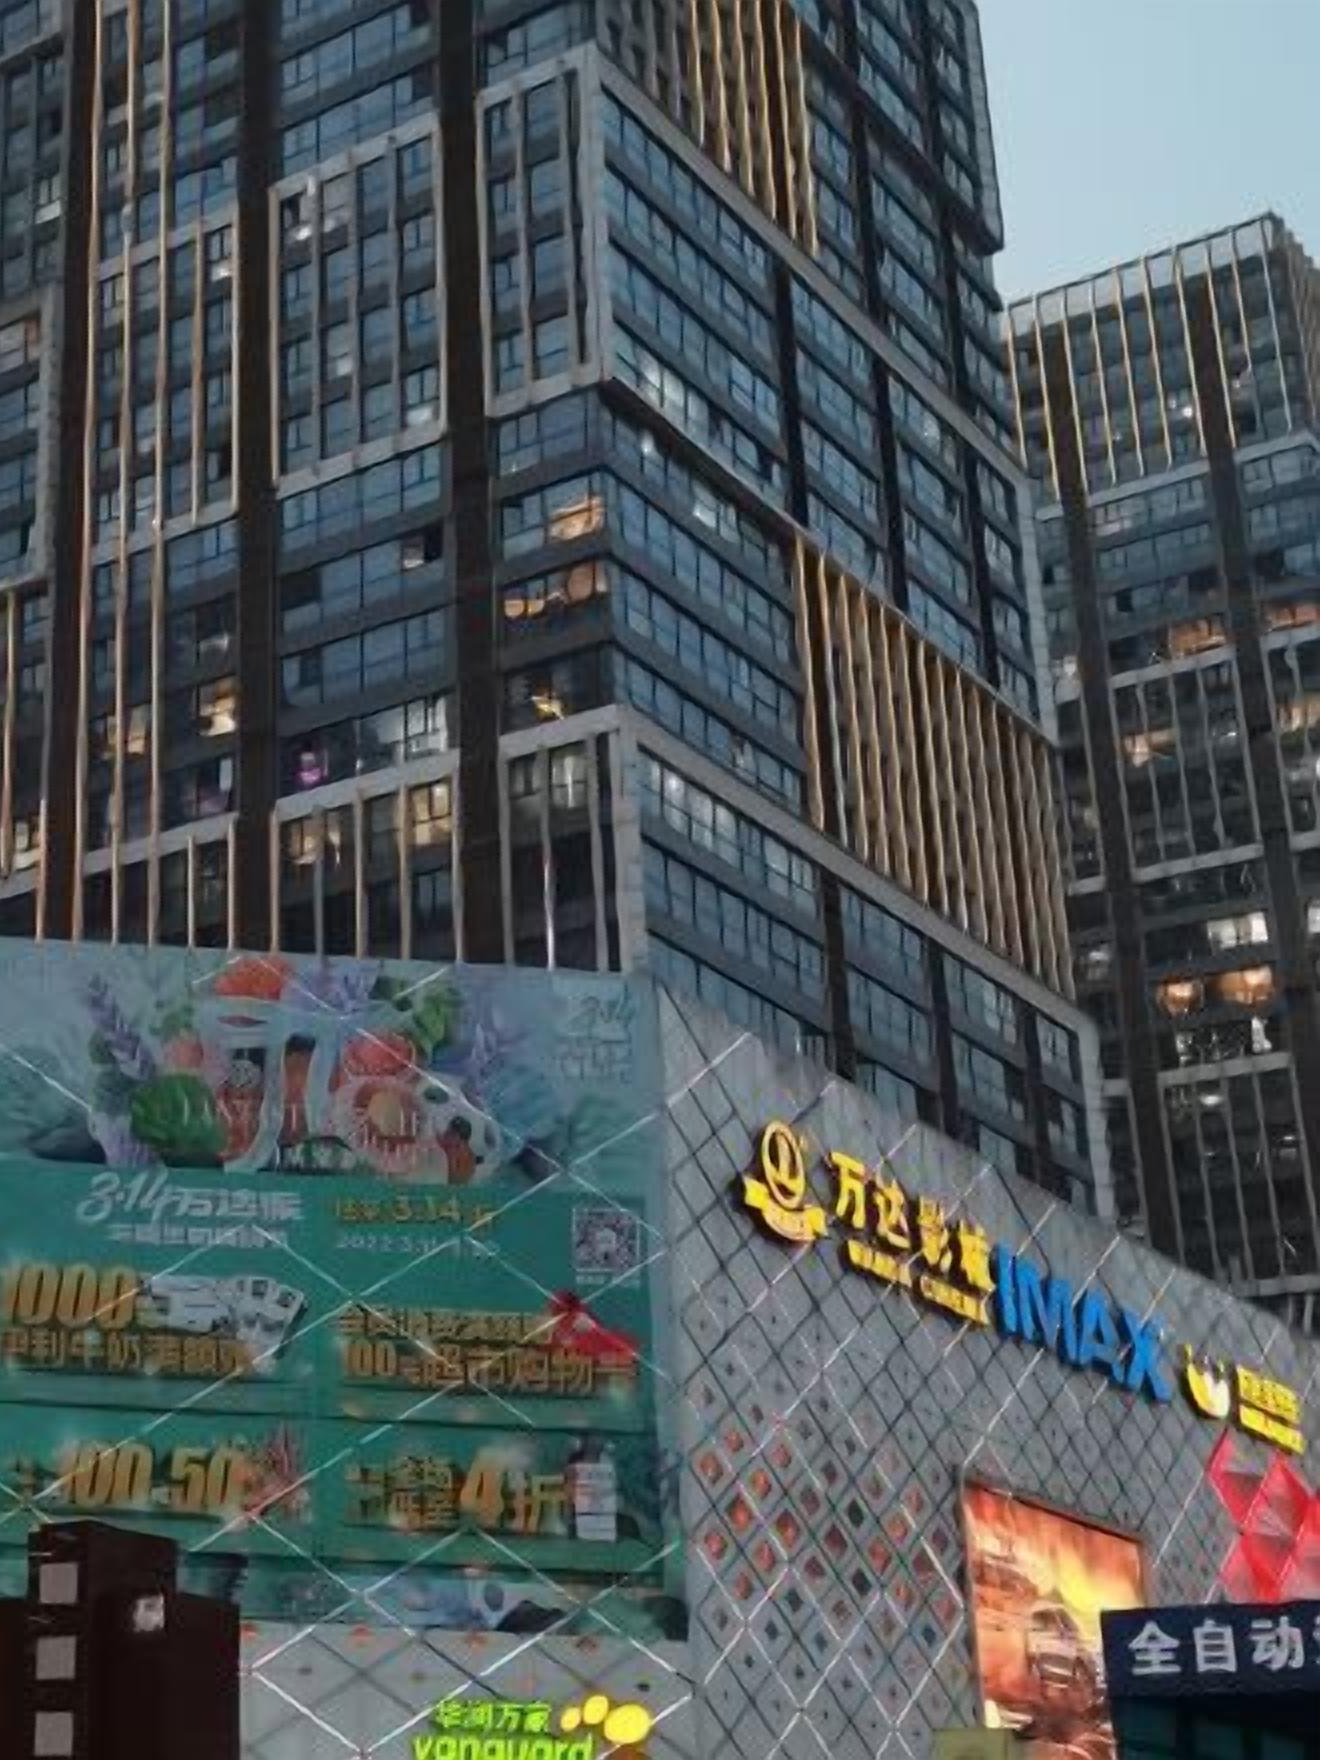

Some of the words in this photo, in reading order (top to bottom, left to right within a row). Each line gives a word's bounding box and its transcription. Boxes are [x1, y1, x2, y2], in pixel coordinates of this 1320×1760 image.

[995, 1241, 1173, 1403] IMAX
[1128, 1615, 1320, 1676] 全自动
